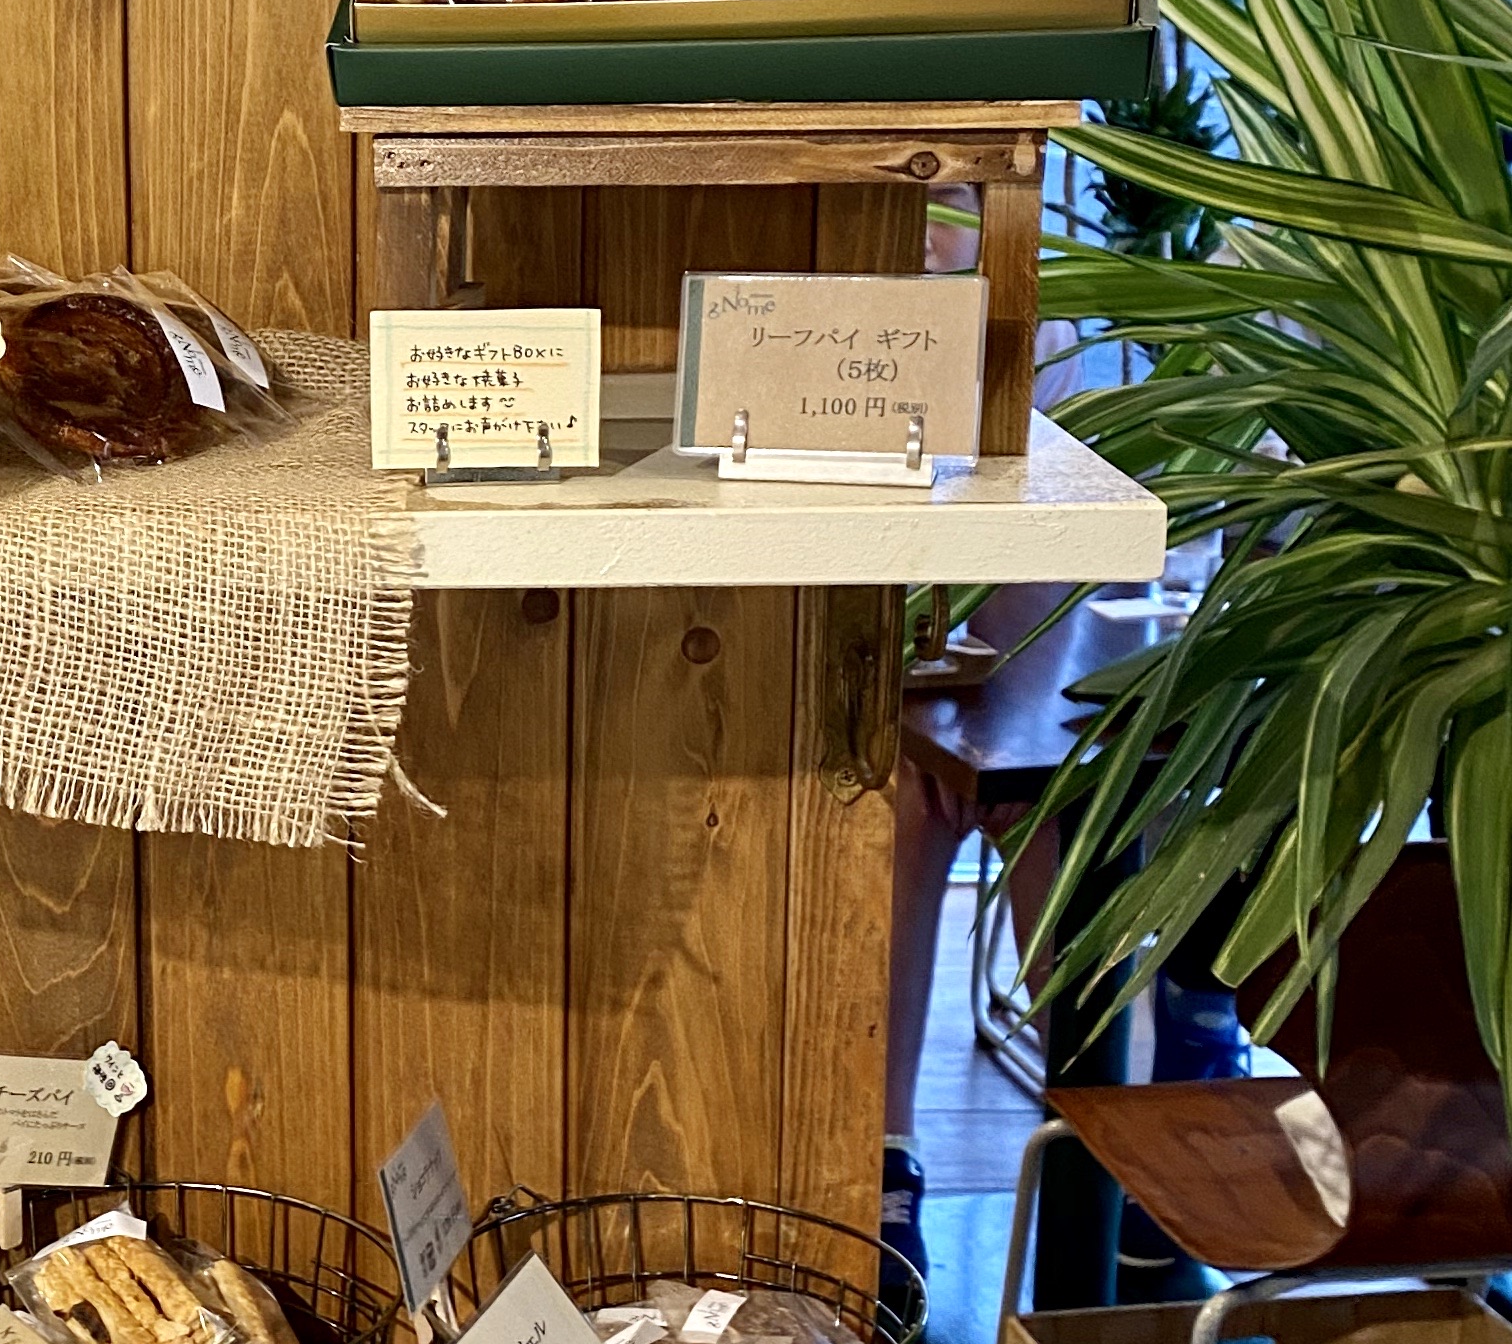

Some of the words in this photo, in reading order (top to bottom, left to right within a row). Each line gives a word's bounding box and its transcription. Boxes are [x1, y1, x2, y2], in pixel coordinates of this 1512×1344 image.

[751, 328, 860, 350] リーフパイ
[876, 329, 937, 351] ギフト
[410, 342, 564, 363] お好きなギフトBOXに
[838, 358, 898, 382] (5枚)
[406, 395, 492, 412] お詰めします
[800, 397, 857, 416] 1,100
[408, 417, 562, 434] スタッにお声がけ下い
